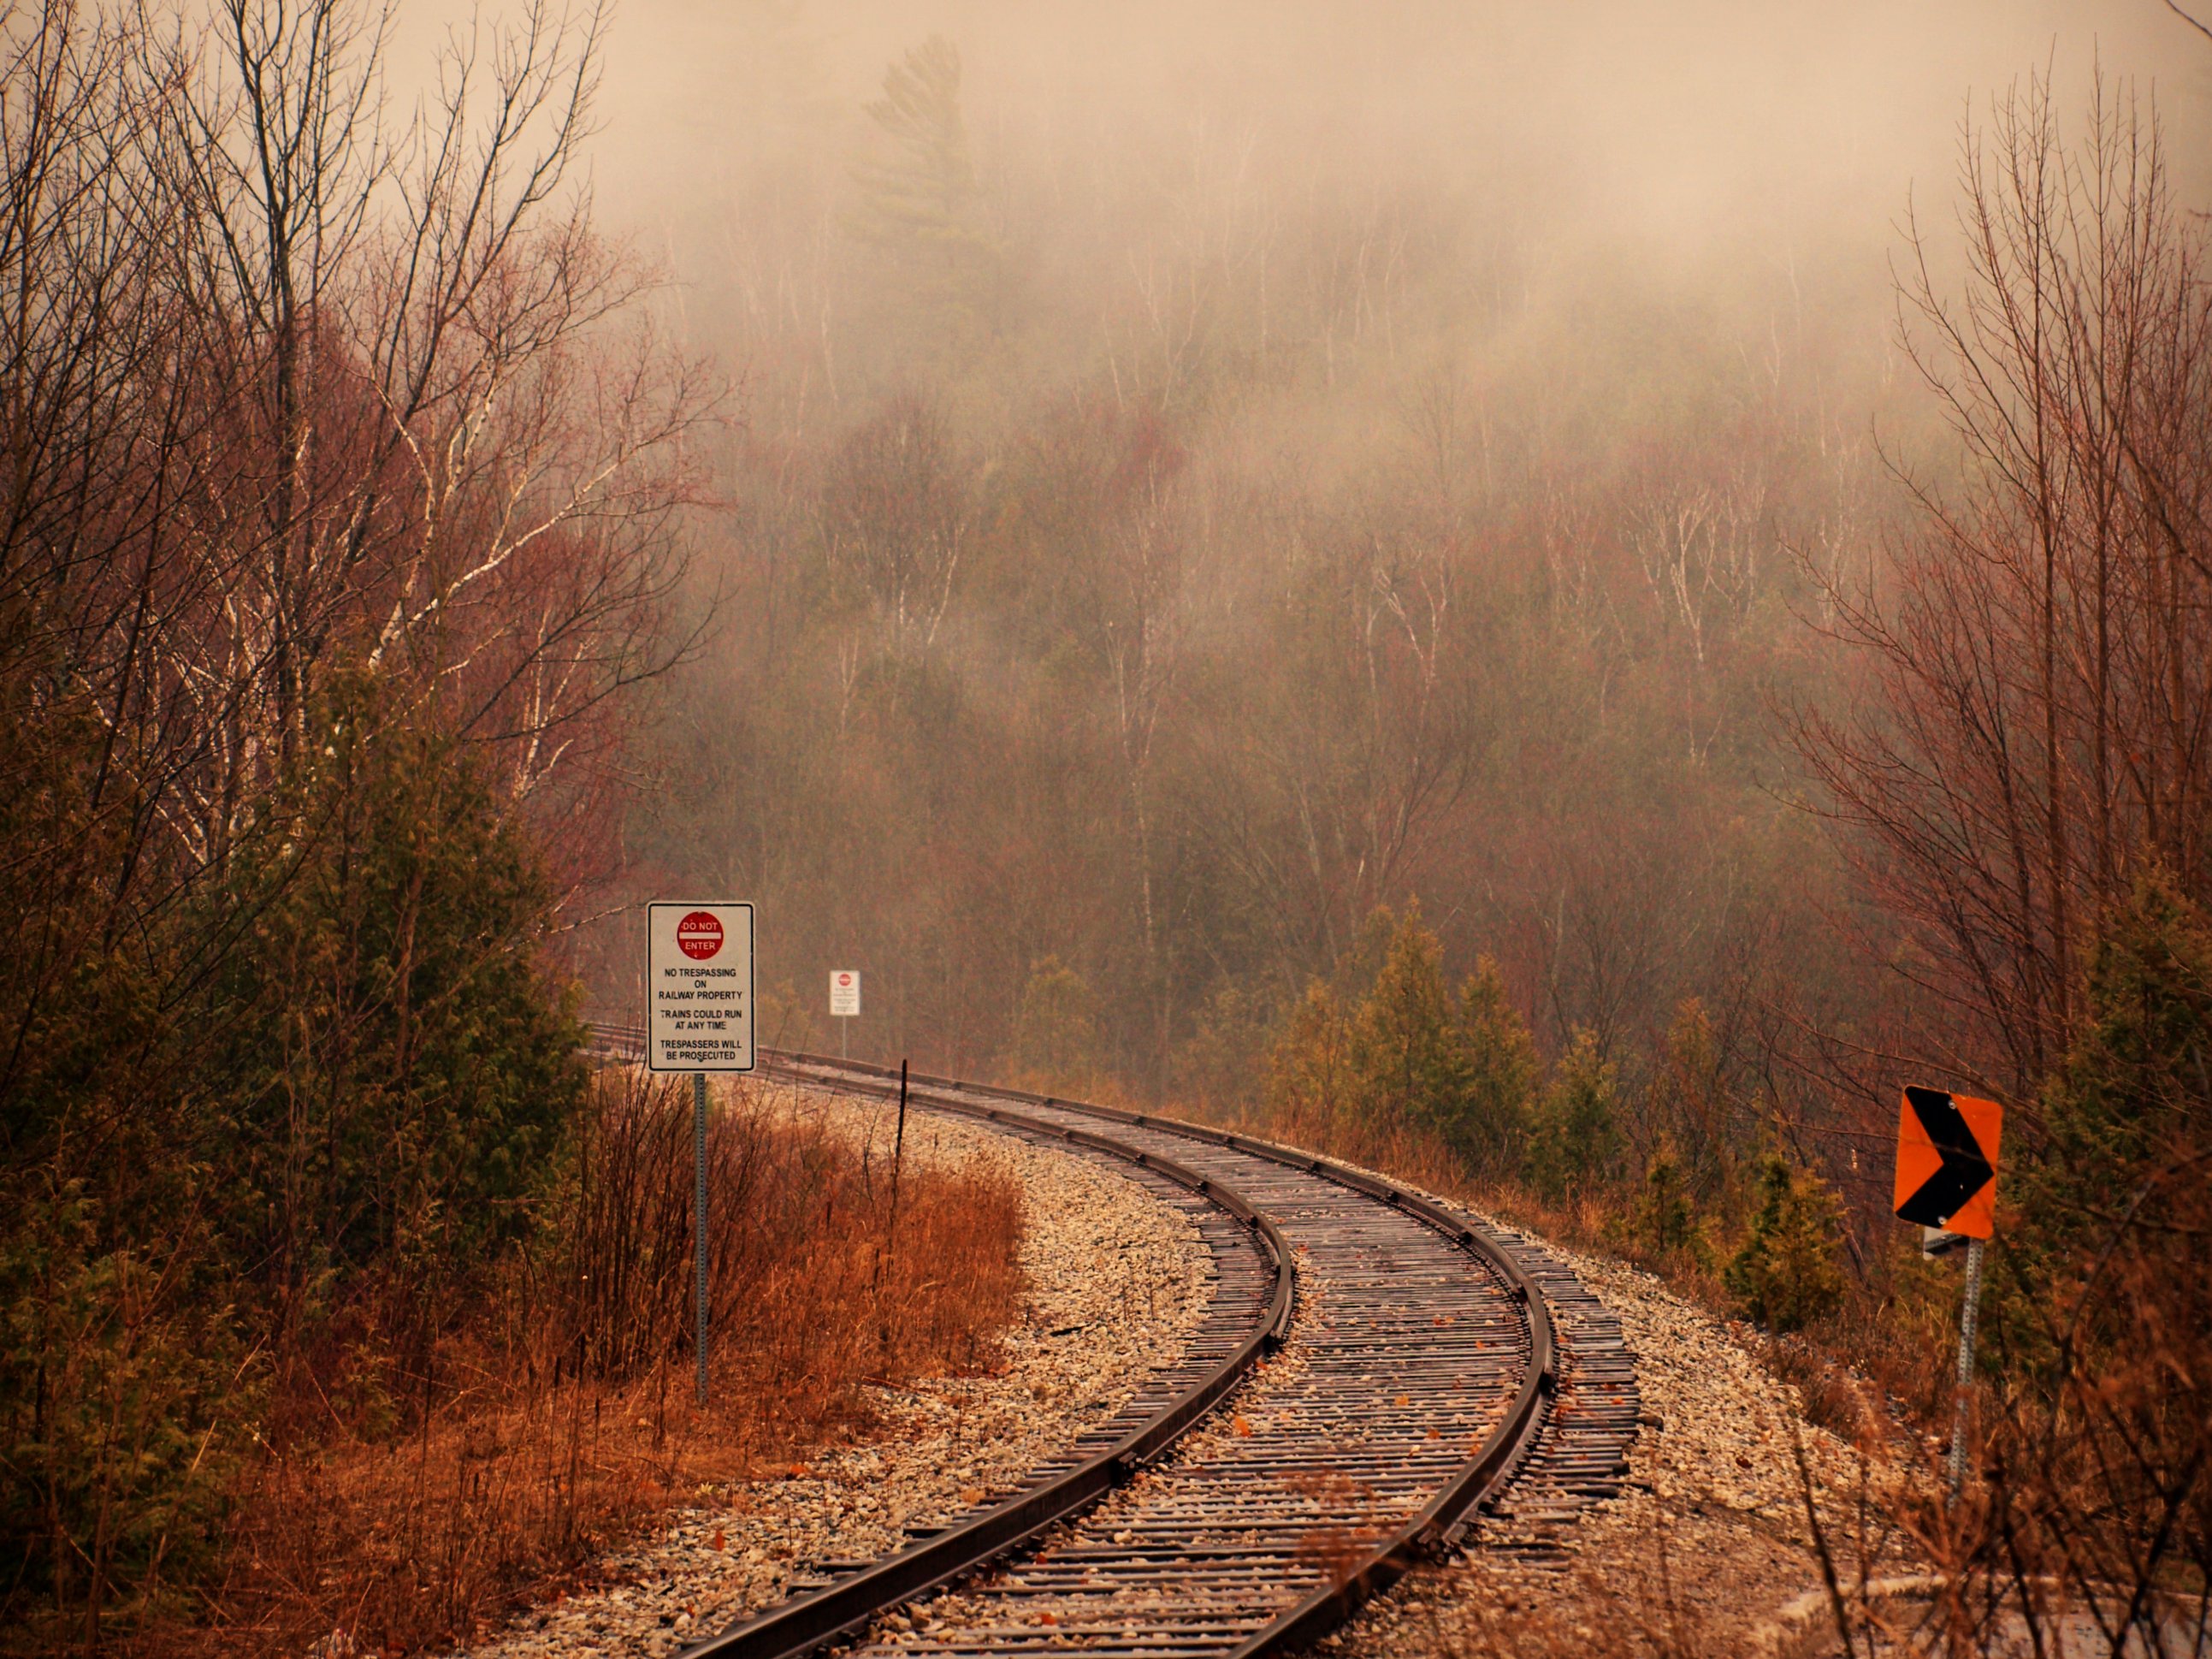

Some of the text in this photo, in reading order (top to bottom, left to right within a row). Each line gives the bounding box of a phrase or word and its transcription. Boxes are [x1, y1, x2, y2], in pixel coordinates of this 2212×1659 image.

[683, 922, 718, 930] DO NOT
[685, 942, 716, 950] ENTER
[665, 969, 736, 977] NO TRESPASSING
[694, 980, 706, 988] ON
[659, 991, 742, 1000] RAILWAY PROPERTY
[661, 1010, 742, 1018] TRAINS COULD RUN
[675, 1021, 726, 1030] AT ANY TIME
[661, 1040, 742, 1048] TRESPASSERS WILL
[667, 1051, 735, 1060] BE PROSECUTED
